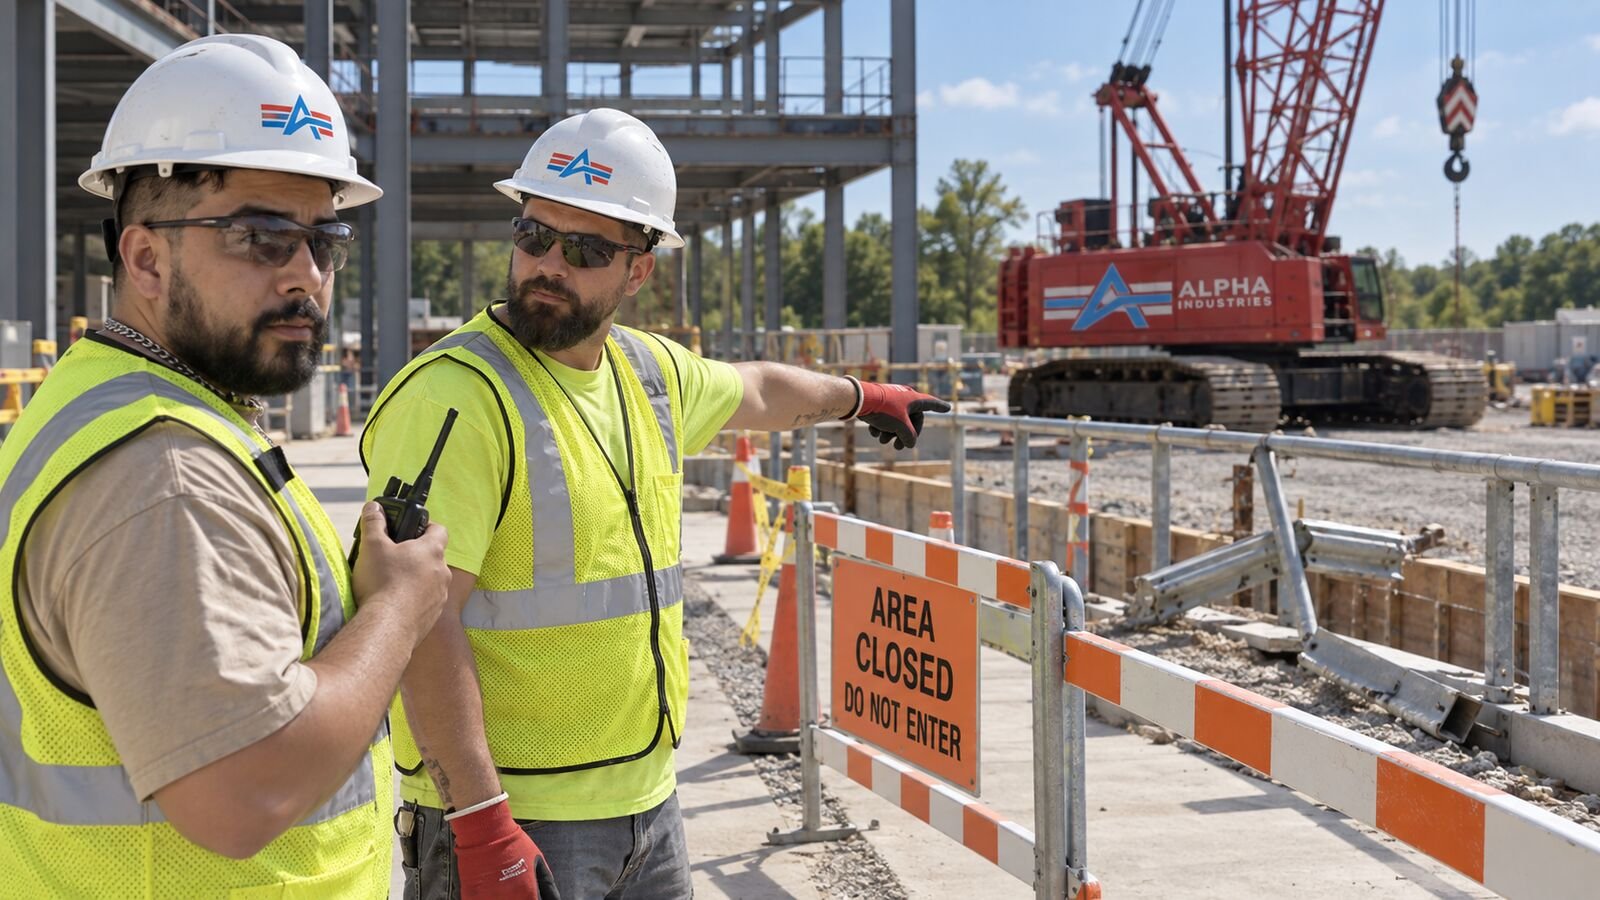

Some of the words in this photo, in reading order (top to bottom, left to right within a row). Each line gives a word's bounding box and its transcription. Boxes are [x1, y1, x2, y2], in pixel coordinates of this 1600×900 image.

[1178, 276, 1270, 298] ALPHA
[1178, 296, 1272, 310] INDUSTRIES
[870, 586, 935, 643] AREA
[855, 631, 954, 702] CLOSED
[844, 681, 864, 718] DO
[869, 691, 901, 733] NOT
[906, 706, 961, 762] ENTER
